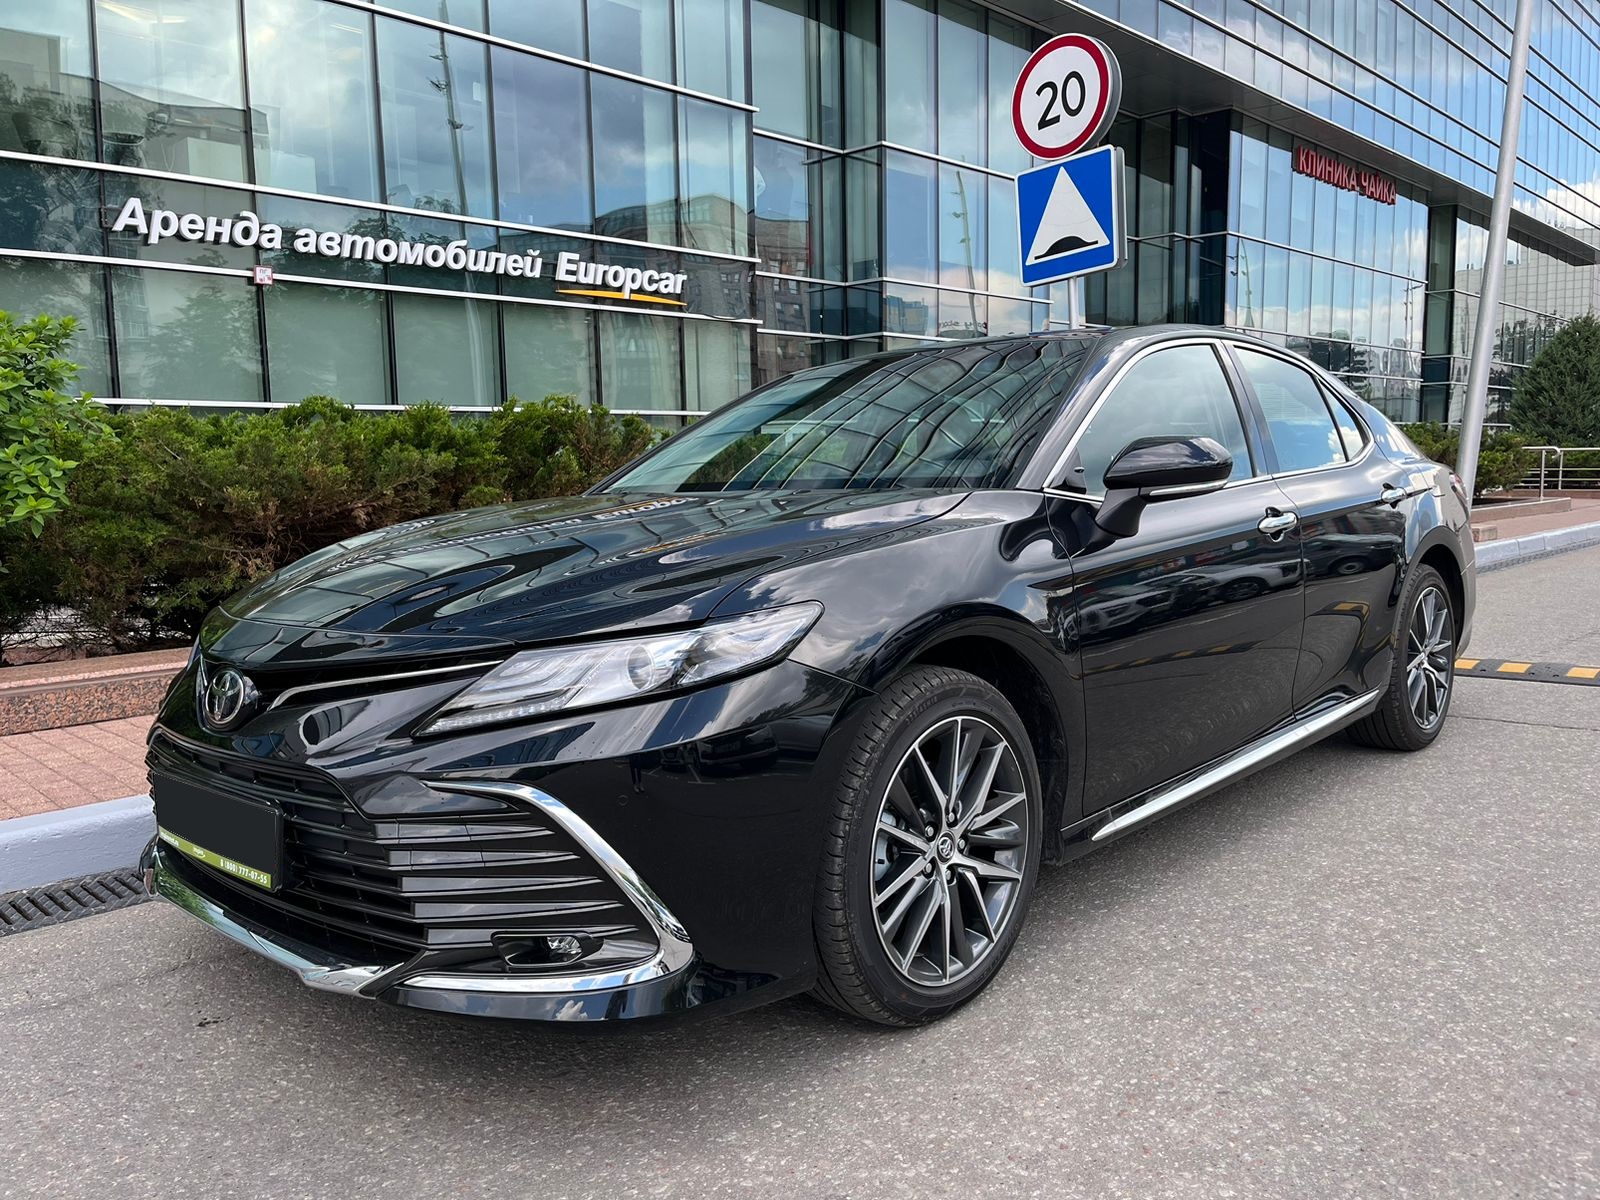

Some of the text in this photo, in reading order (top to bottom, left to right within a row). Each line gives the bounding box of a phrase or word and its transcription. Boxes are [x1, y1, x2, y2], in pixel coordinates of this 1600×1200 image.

[1036, 71, 1086, 130] 20
[1298, 146, 1397, 203] КЛИНИКА ЧАЙКА
[112, 197, 687, 299] Аренда автомобилей Europcar
[238, 866, 267, 884] 777-07-55
